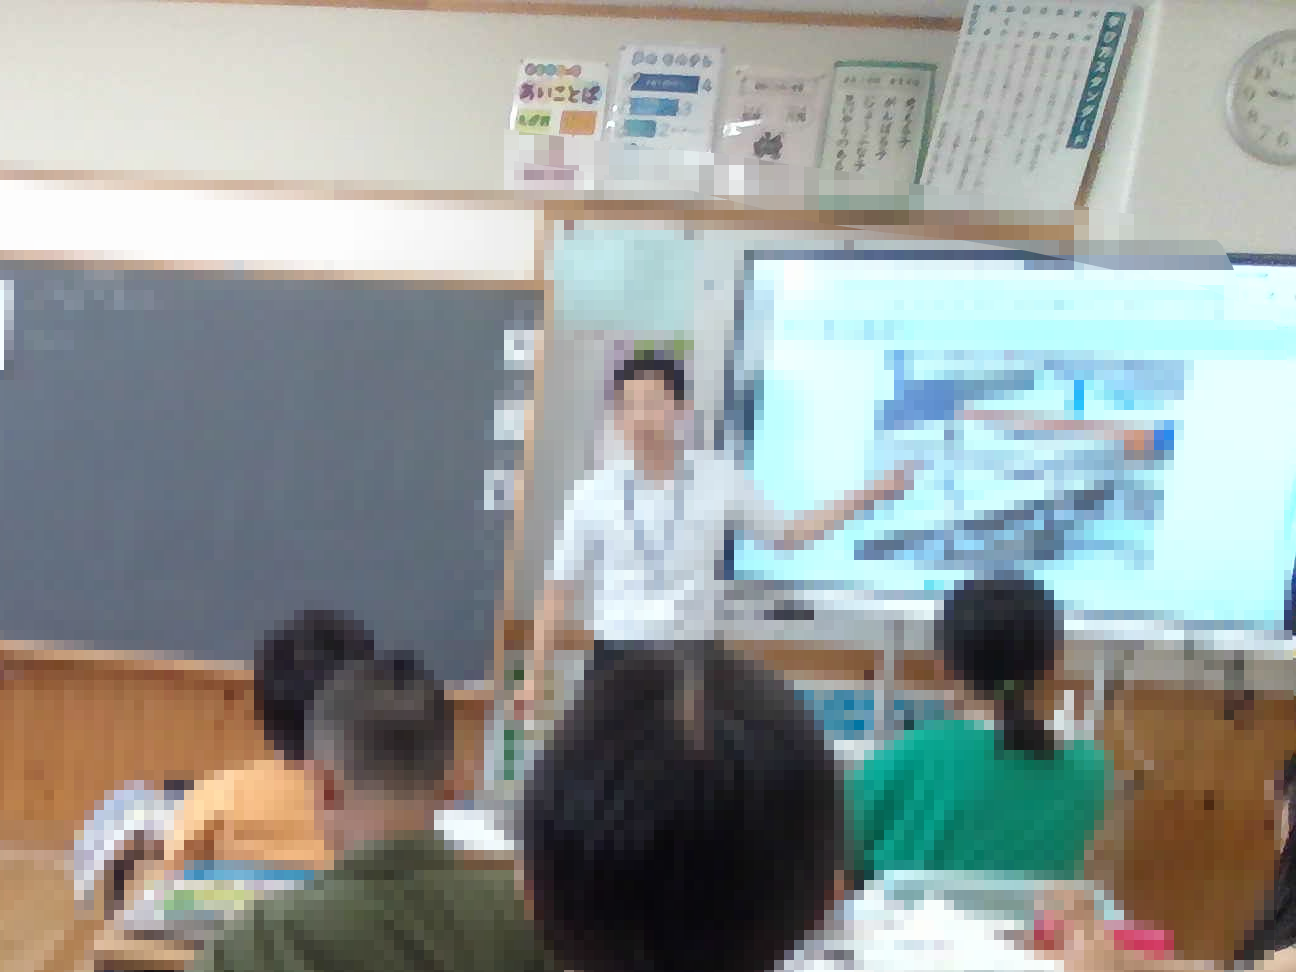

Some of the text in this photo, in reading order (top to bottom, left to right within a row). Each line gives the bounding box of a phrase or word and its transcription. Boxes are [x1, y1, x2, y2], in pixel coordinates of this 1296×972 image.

[519, 81, 601, 104] あいことば
